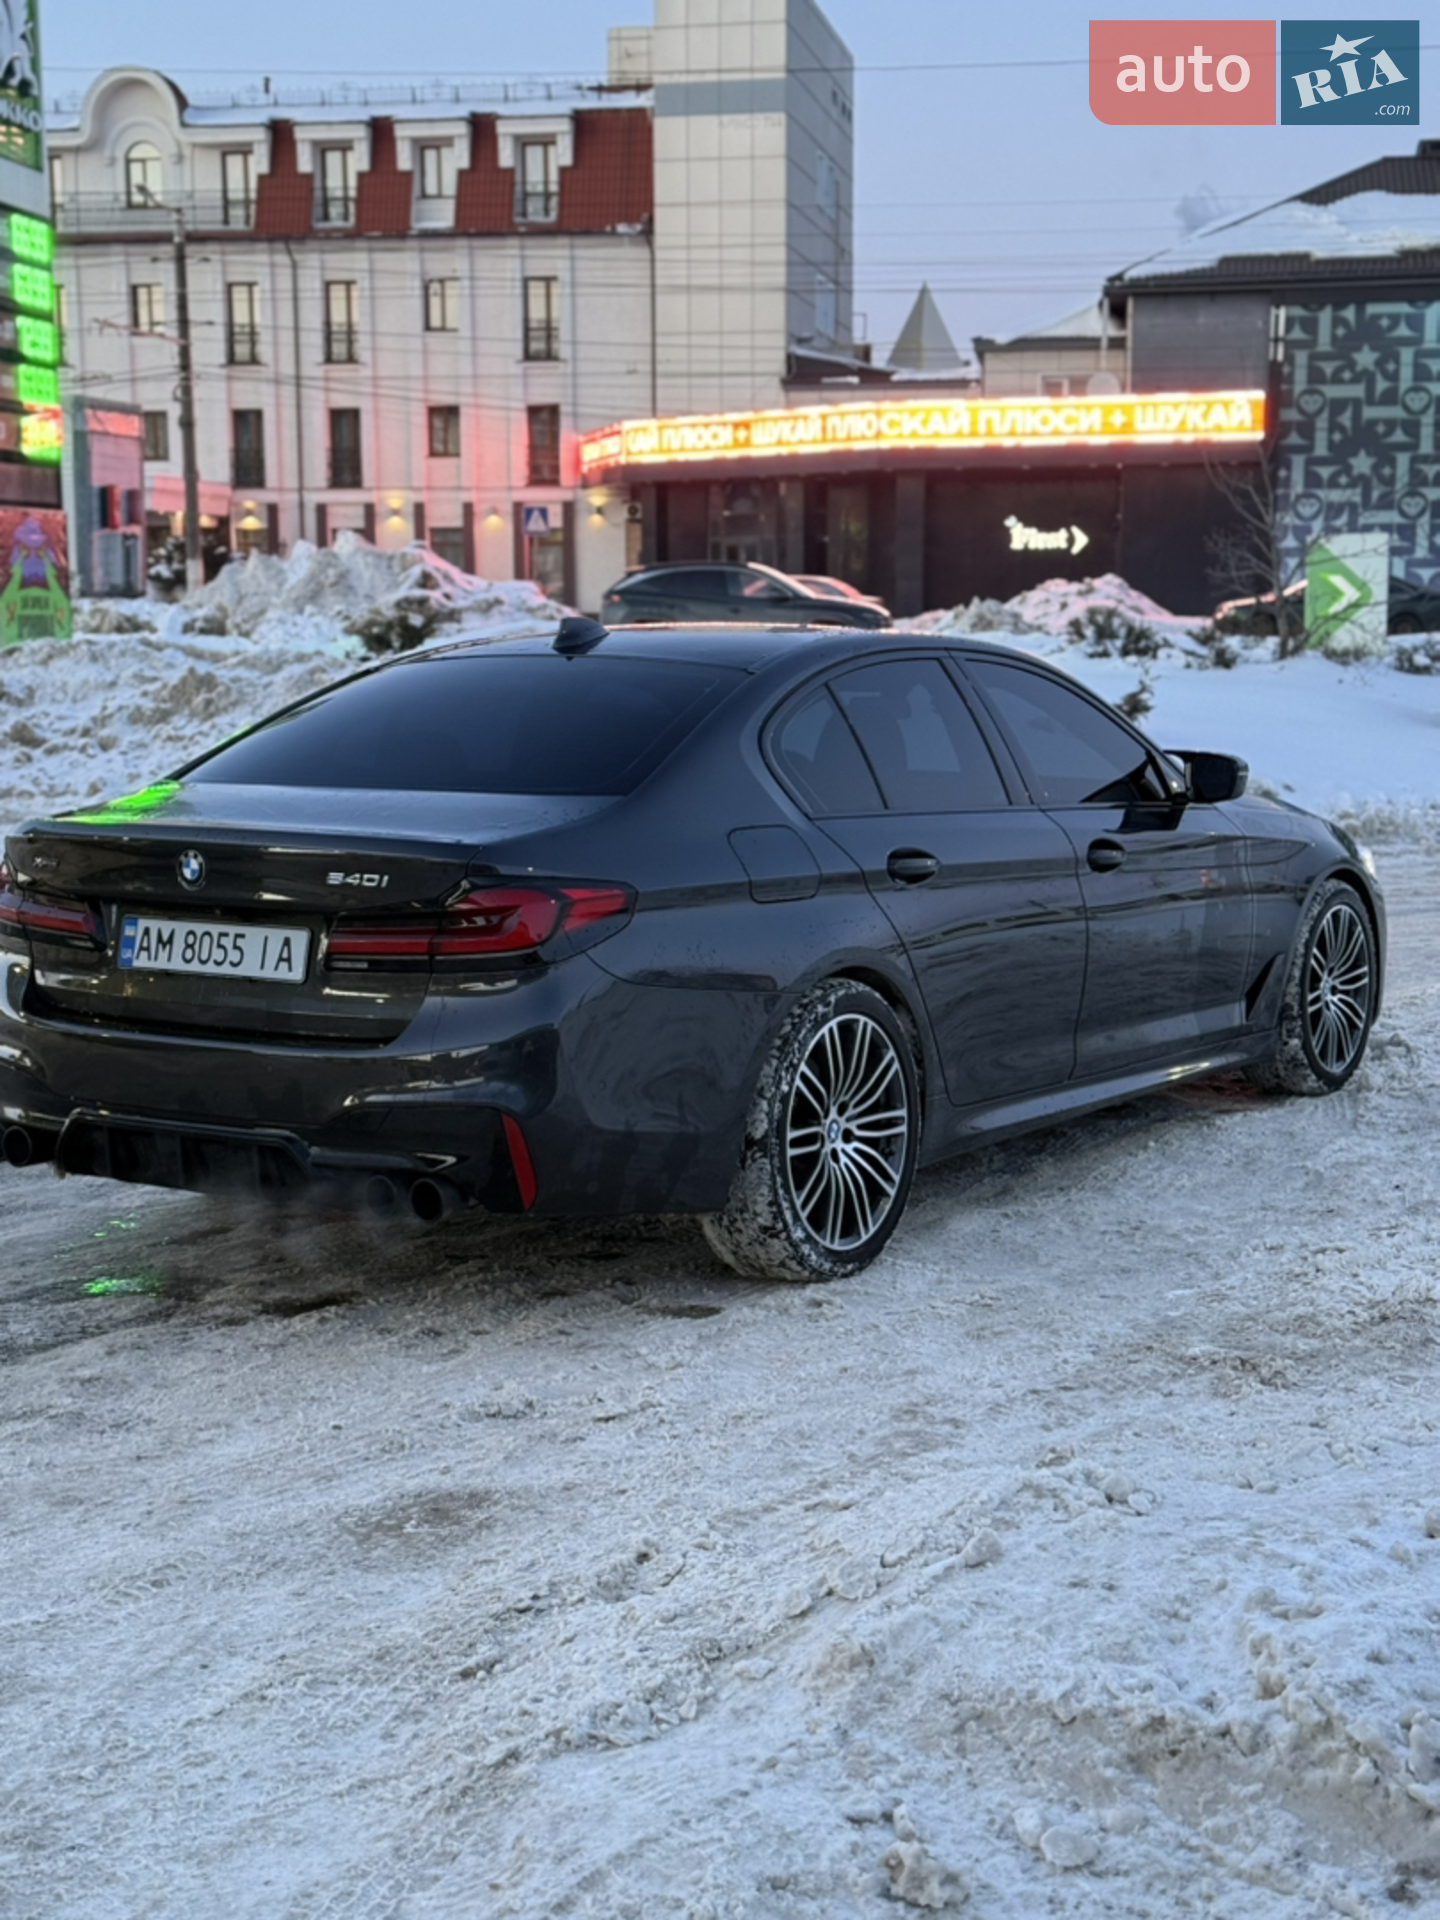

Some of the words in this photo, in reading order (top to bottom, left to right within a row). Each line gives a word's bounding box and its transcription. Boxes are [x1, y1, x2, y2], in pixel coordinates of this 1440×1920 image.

[751, 411, 822, 446] ШУКАЙ
[978, 407, 1102, 435] ПЛЮСИ
[1135, 398, 1252, 433] ШУКАЙ
[135, 925, 175, 963] AM
[181, 929, 246, 968] 8055
